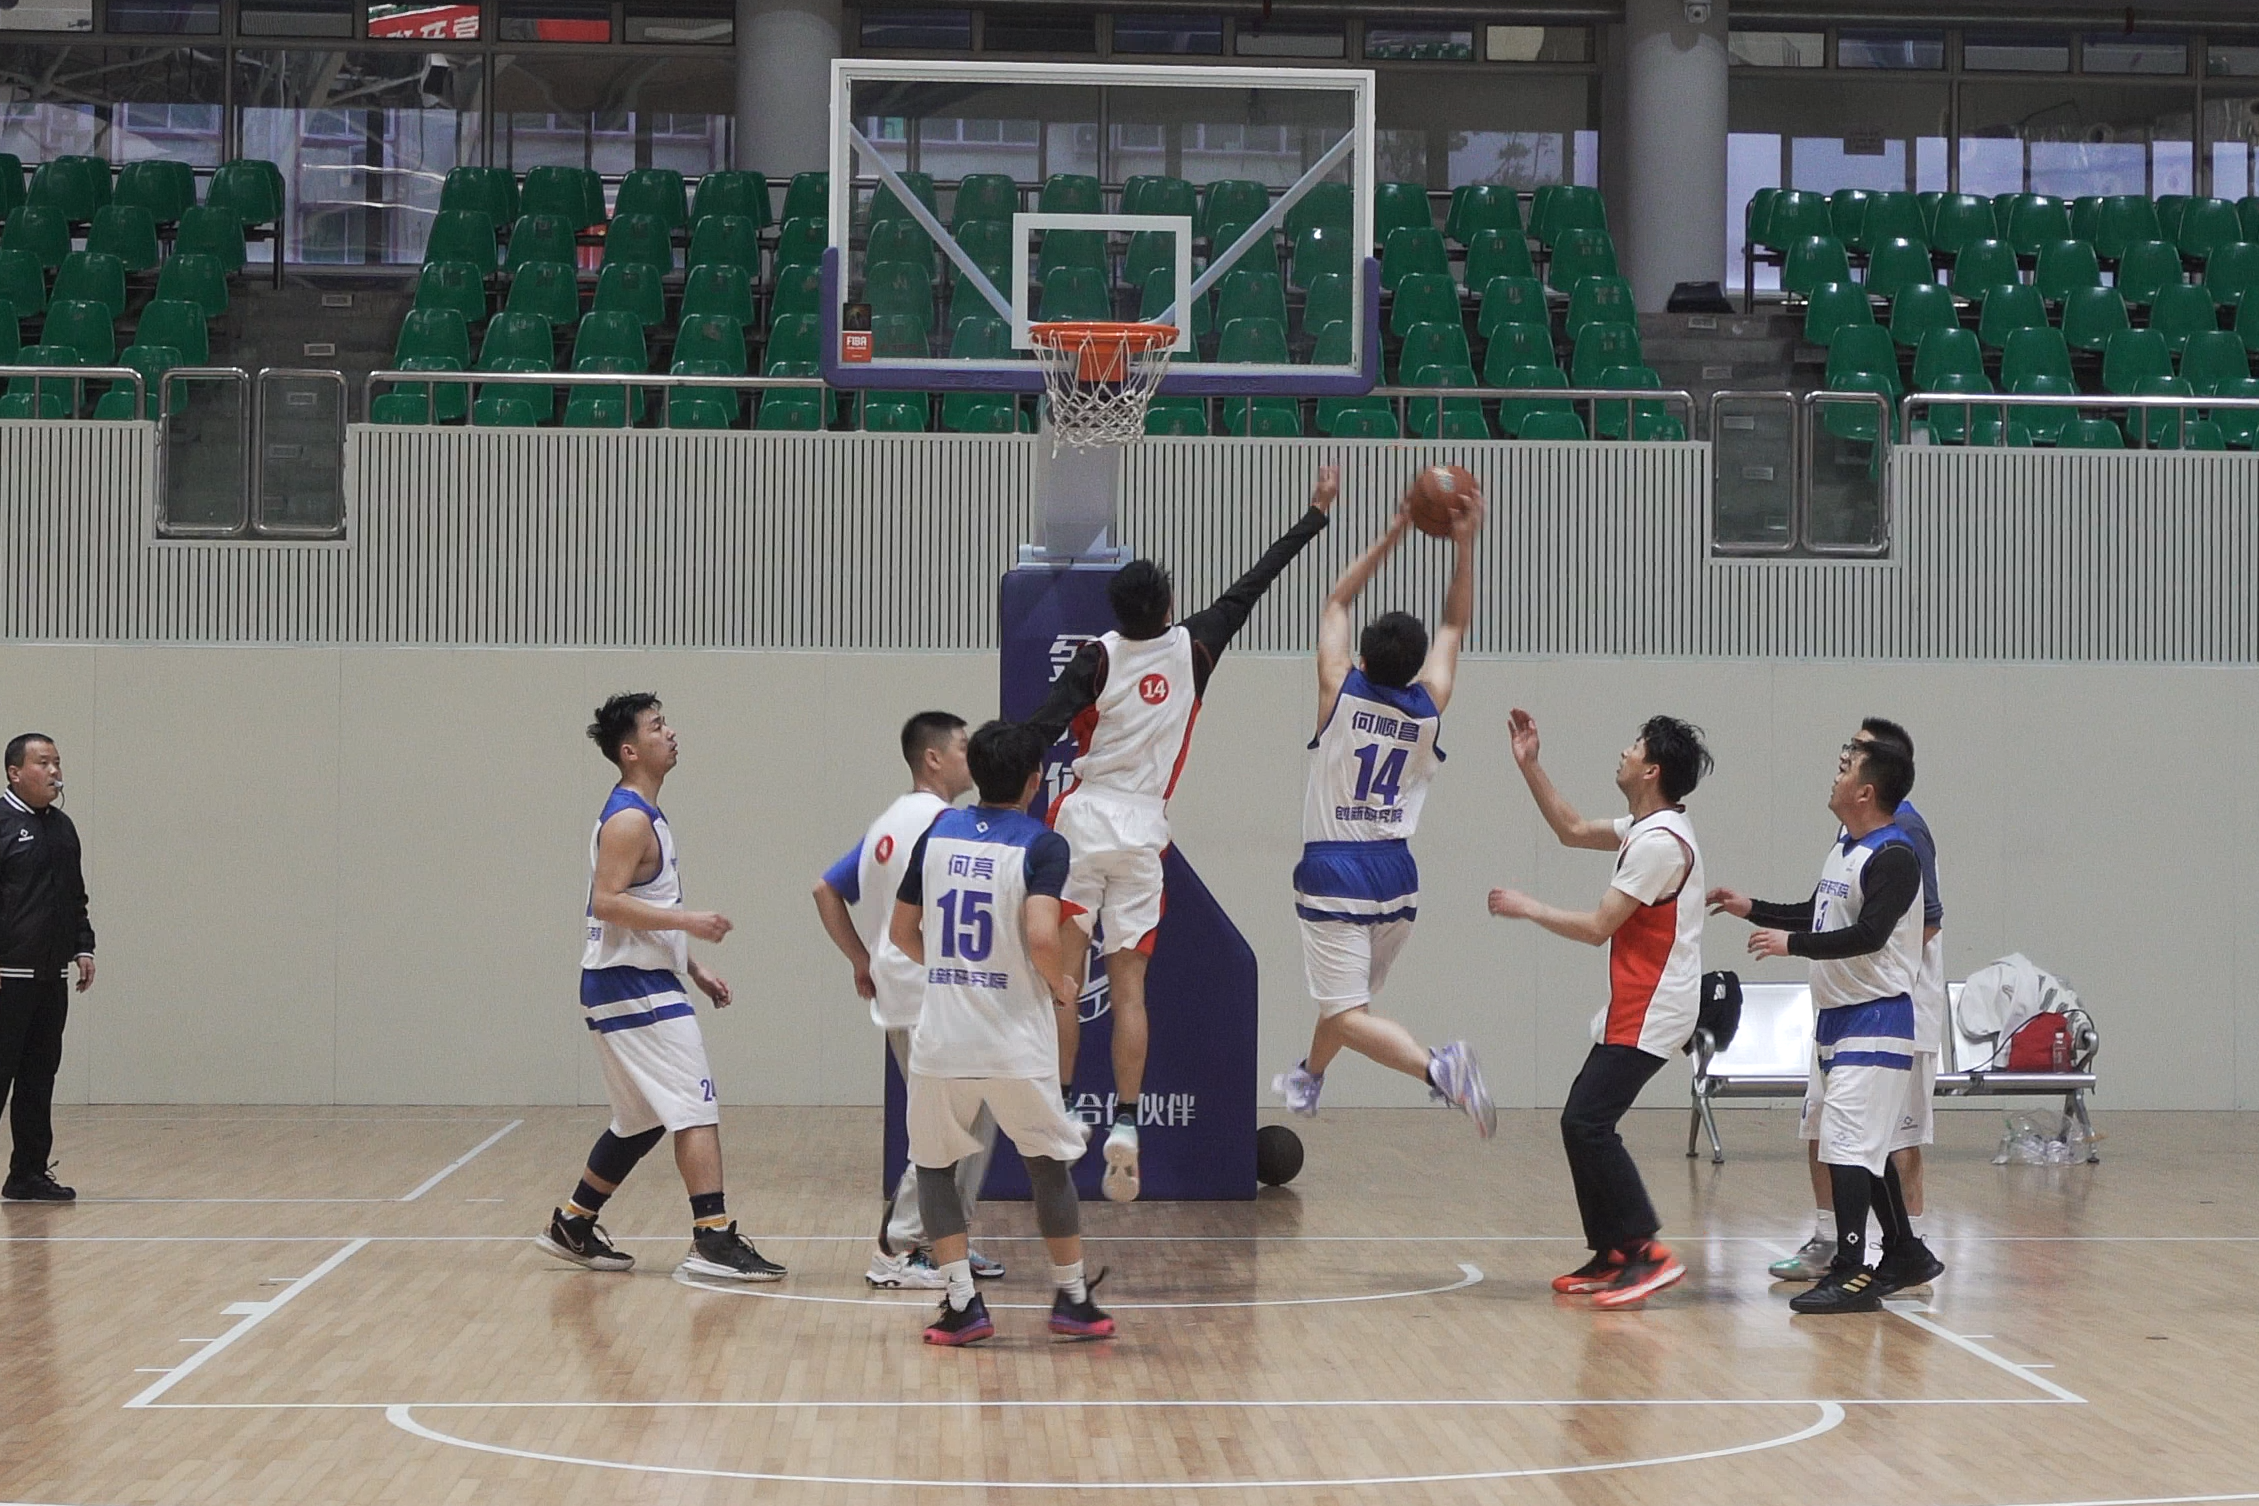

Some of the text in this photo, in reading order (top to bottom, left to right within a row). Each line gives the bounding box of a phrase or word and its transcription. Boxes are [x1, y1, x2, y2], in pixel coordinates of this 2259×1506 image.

[846, 335, 867, 347] FIBA
[1142, 679, 1166, 699] 14
[1351, 710, 1420, 743] 何顺昌
[1353, 743, 1409, 806] 14
[948, 853, 994, 881] 何亮
[937, 888, 993, 962] 15
